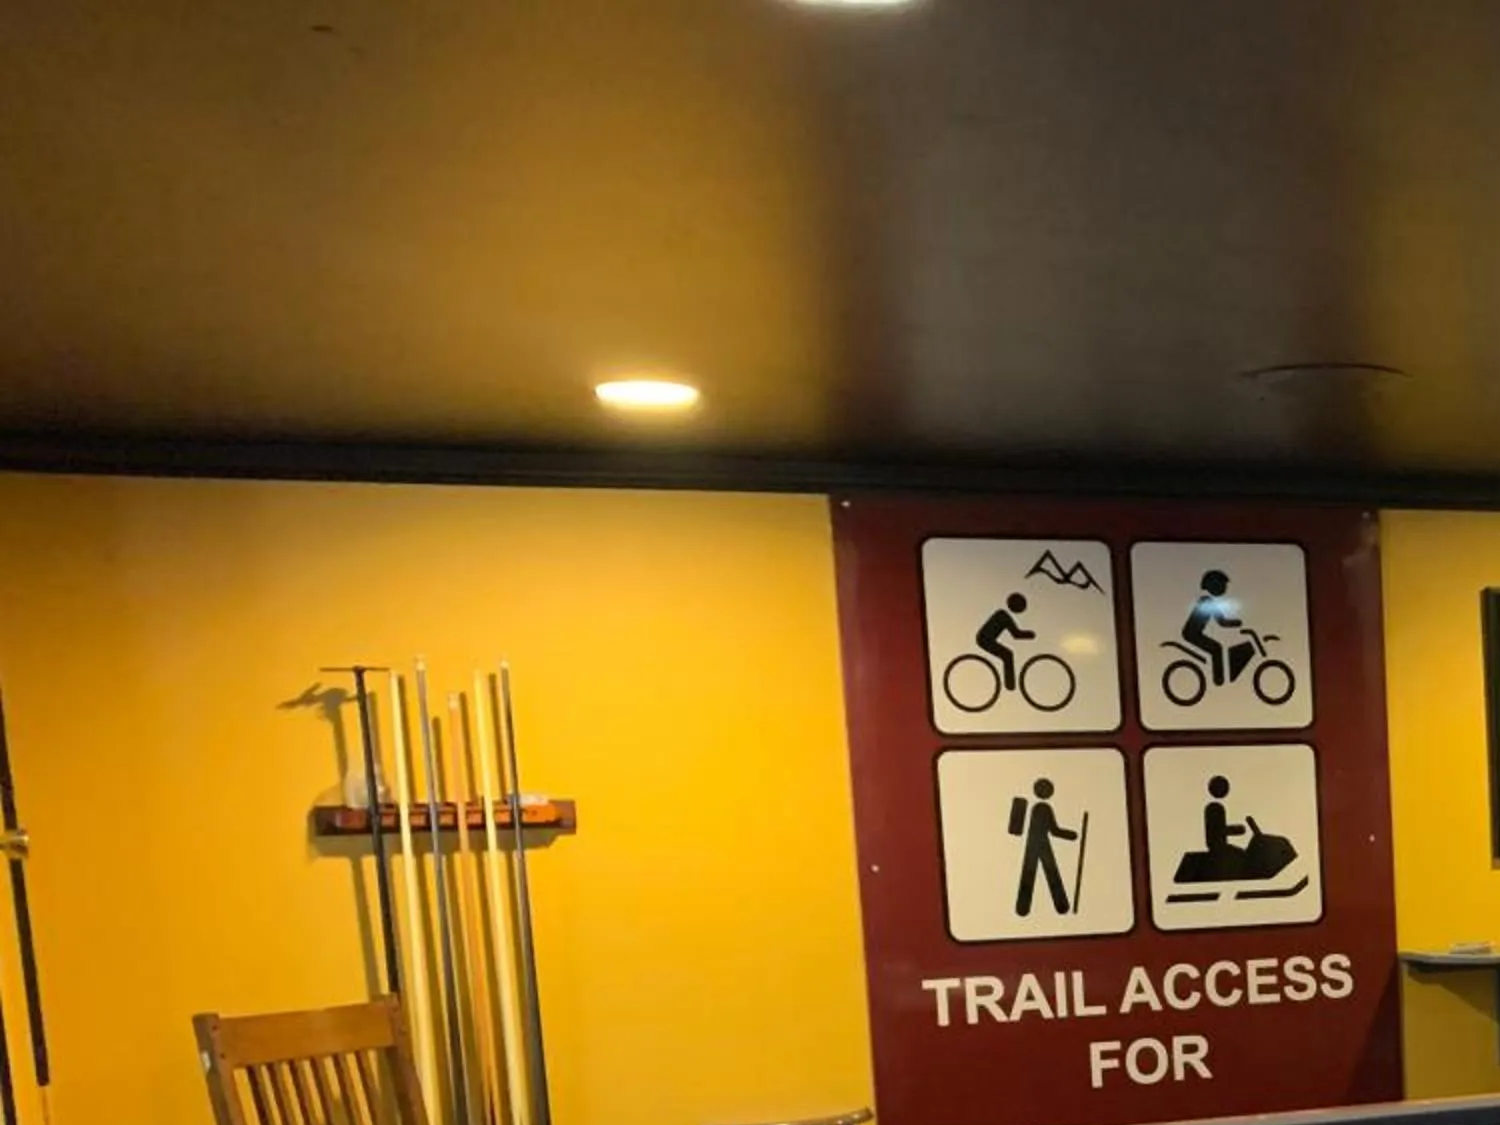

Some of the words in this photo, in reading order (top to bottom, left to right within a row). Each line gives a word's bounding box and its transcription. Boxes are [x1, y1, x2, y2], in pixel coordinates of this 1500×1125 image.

[922, 970, 1106, 1027] TRAIL
[1119, 953, 1354, 1014] ACCESS
[1089, 1034, 1213, 1088] FOR
